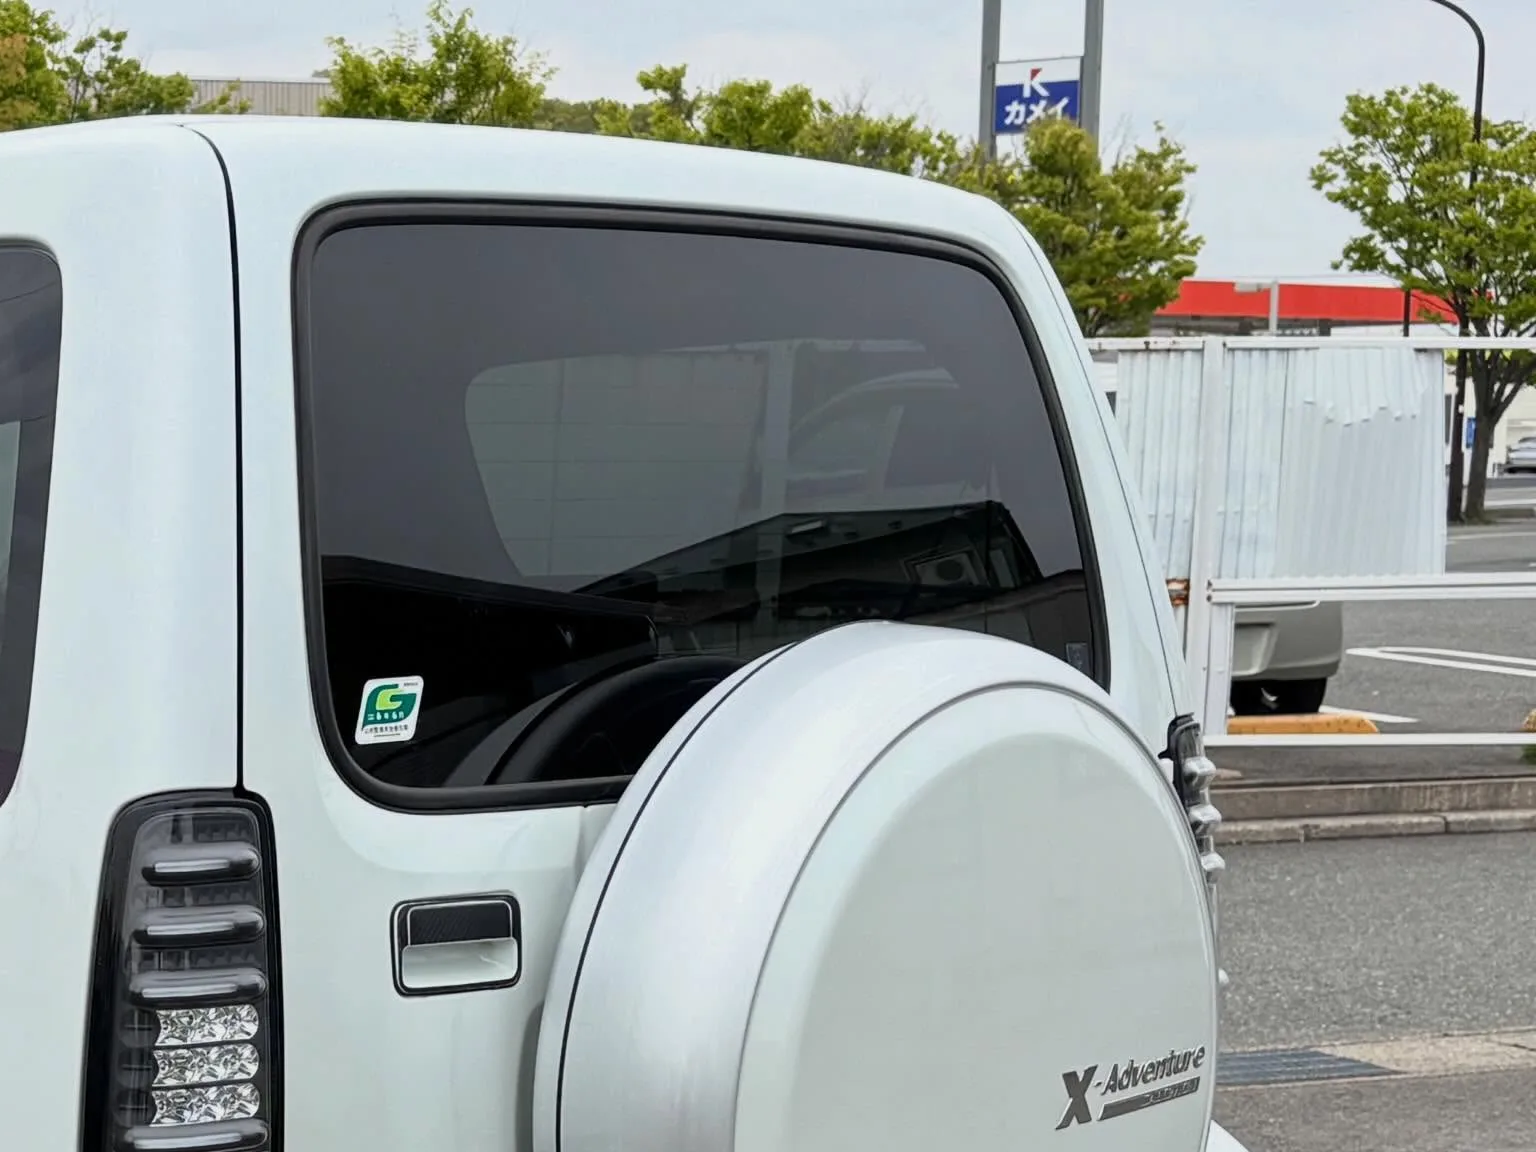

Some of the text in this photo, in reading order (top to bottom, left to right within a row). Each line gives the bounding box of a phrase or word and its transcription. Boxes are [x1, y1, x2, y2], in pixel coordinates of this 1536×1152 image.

[1004, 97, 1070, 126] カメイ
[1054, 1045, 1206, 1131] X-Adventure
